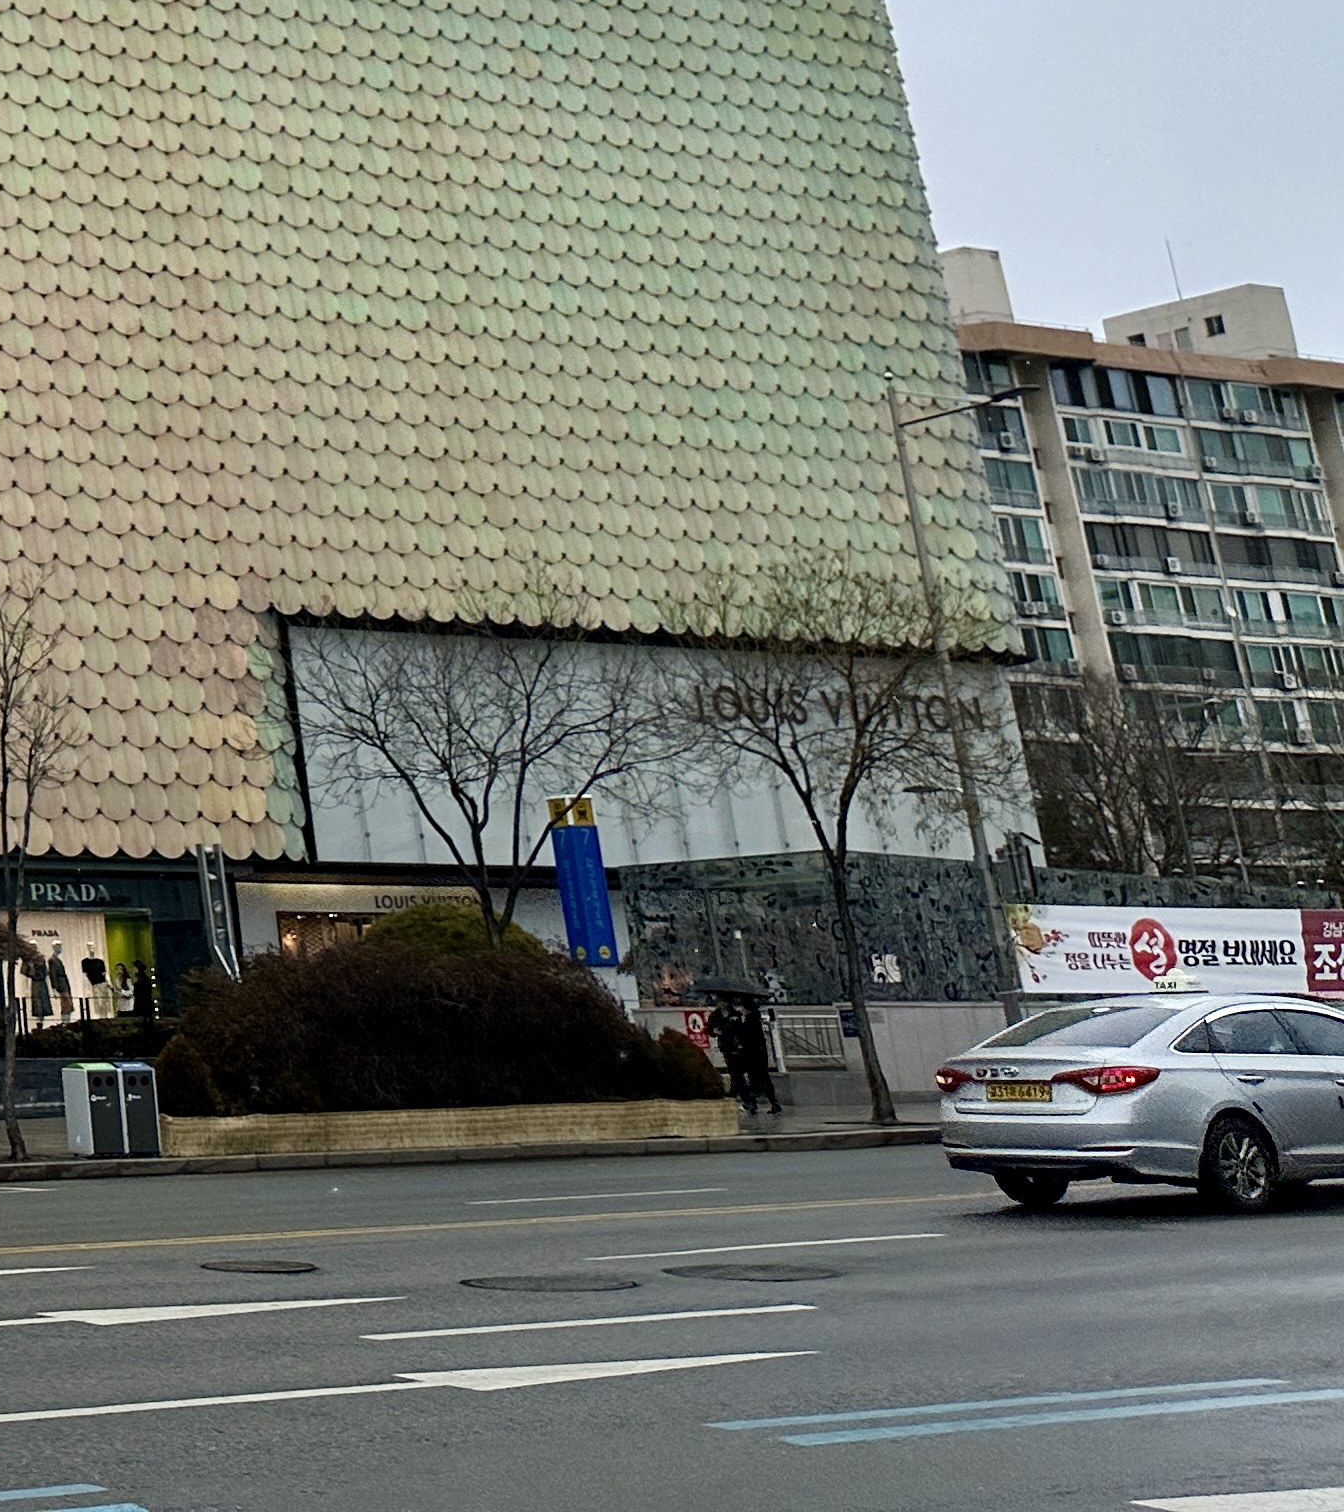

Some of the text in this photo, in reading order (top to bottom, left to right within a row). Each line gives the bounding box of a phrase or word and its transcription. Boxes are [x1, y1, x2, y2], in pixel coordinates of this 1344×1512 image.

[30, 882, 112, 902] PRADA
[374, 894, 417, 909] LOUIS
[31, 929, 59, 937] PRADA
[1323, 921, 1344, 938] 강남
[1088, 931, 1128, 948] 따뜻한
[1133, 928, 1297, 975] 설 명절 보내세요
[1064, 952, 1132, 970] 정을 나누는
[1154, 981, 1177, 989] TAXI
